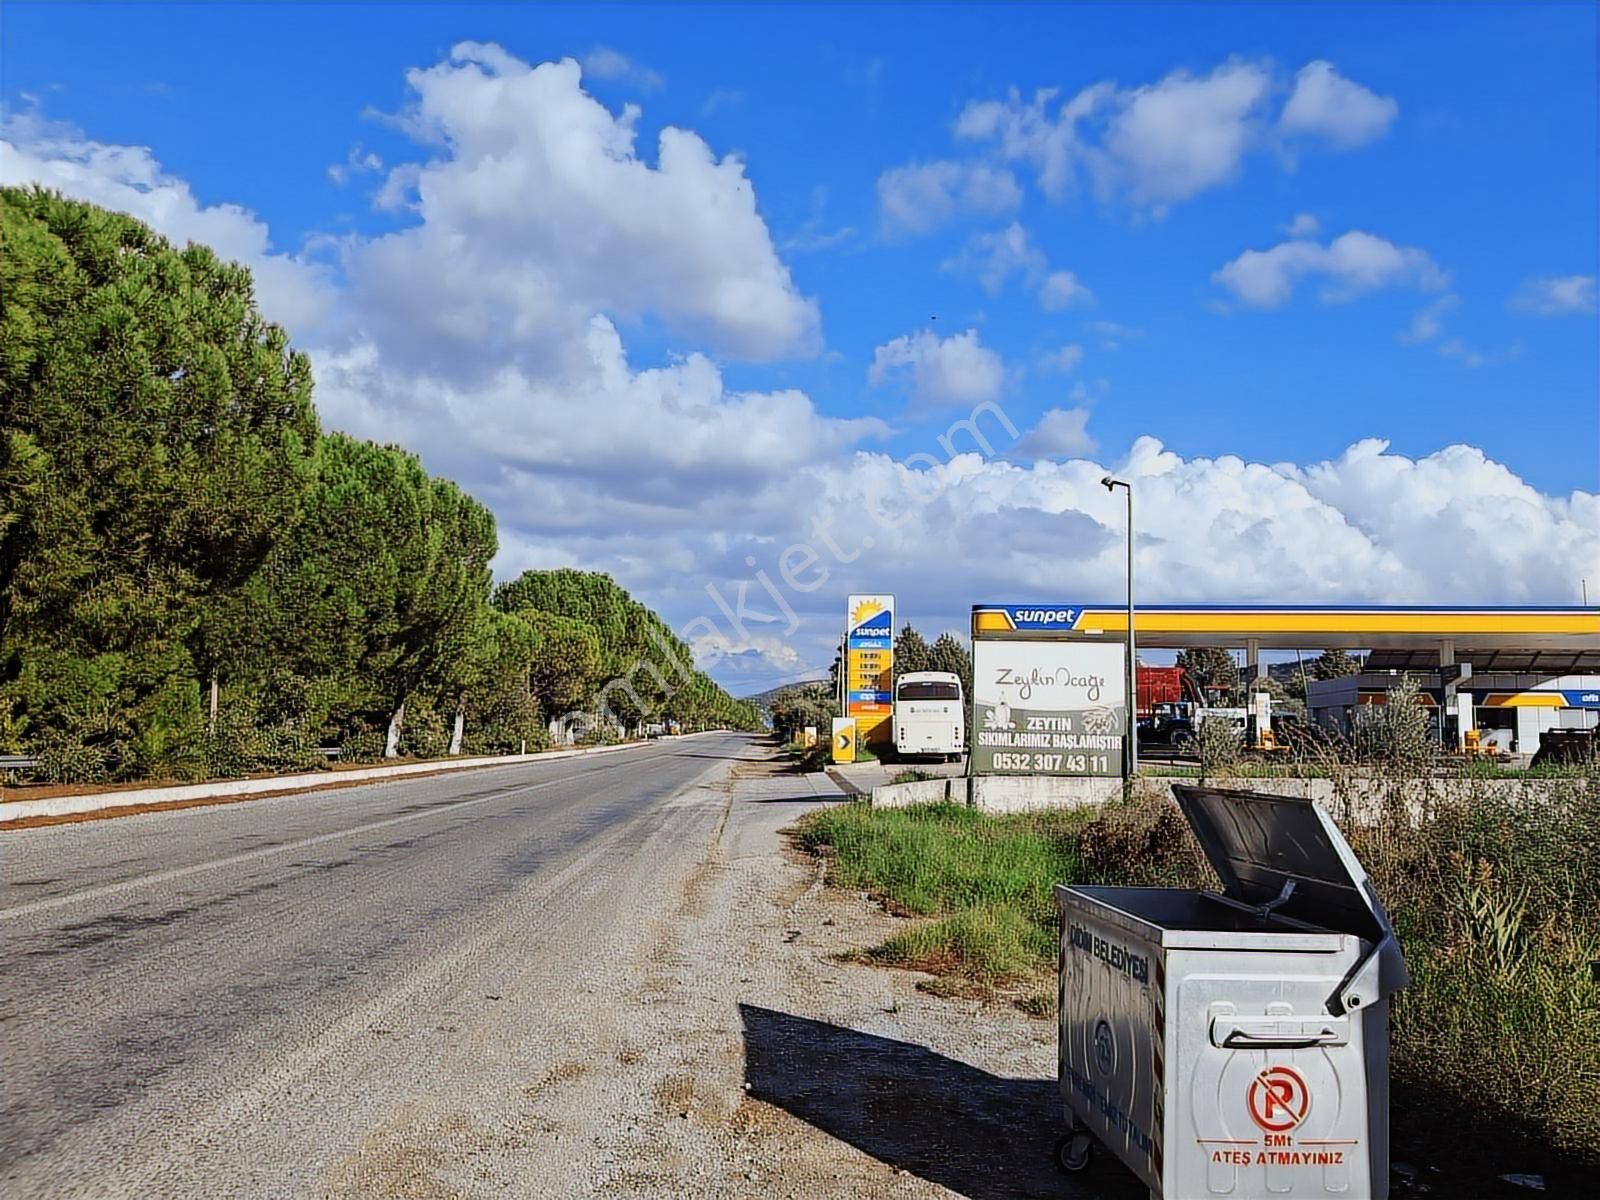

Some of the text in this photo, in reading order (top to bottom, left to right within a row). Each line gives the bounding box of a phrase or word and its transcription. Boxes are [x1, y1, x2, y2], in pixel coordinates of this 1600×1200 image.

[1014, 608, 1075, 624] sunpet
[856, 627, 890, 638] sunpet
[993, 752, 1109, 773] 0532 307 43 11
[1070, 922, 1149, 985] DİDİM BELEDİYESİ
[1212, 1151, 1344, 1166] ATEŞ ATMAYINIZ
